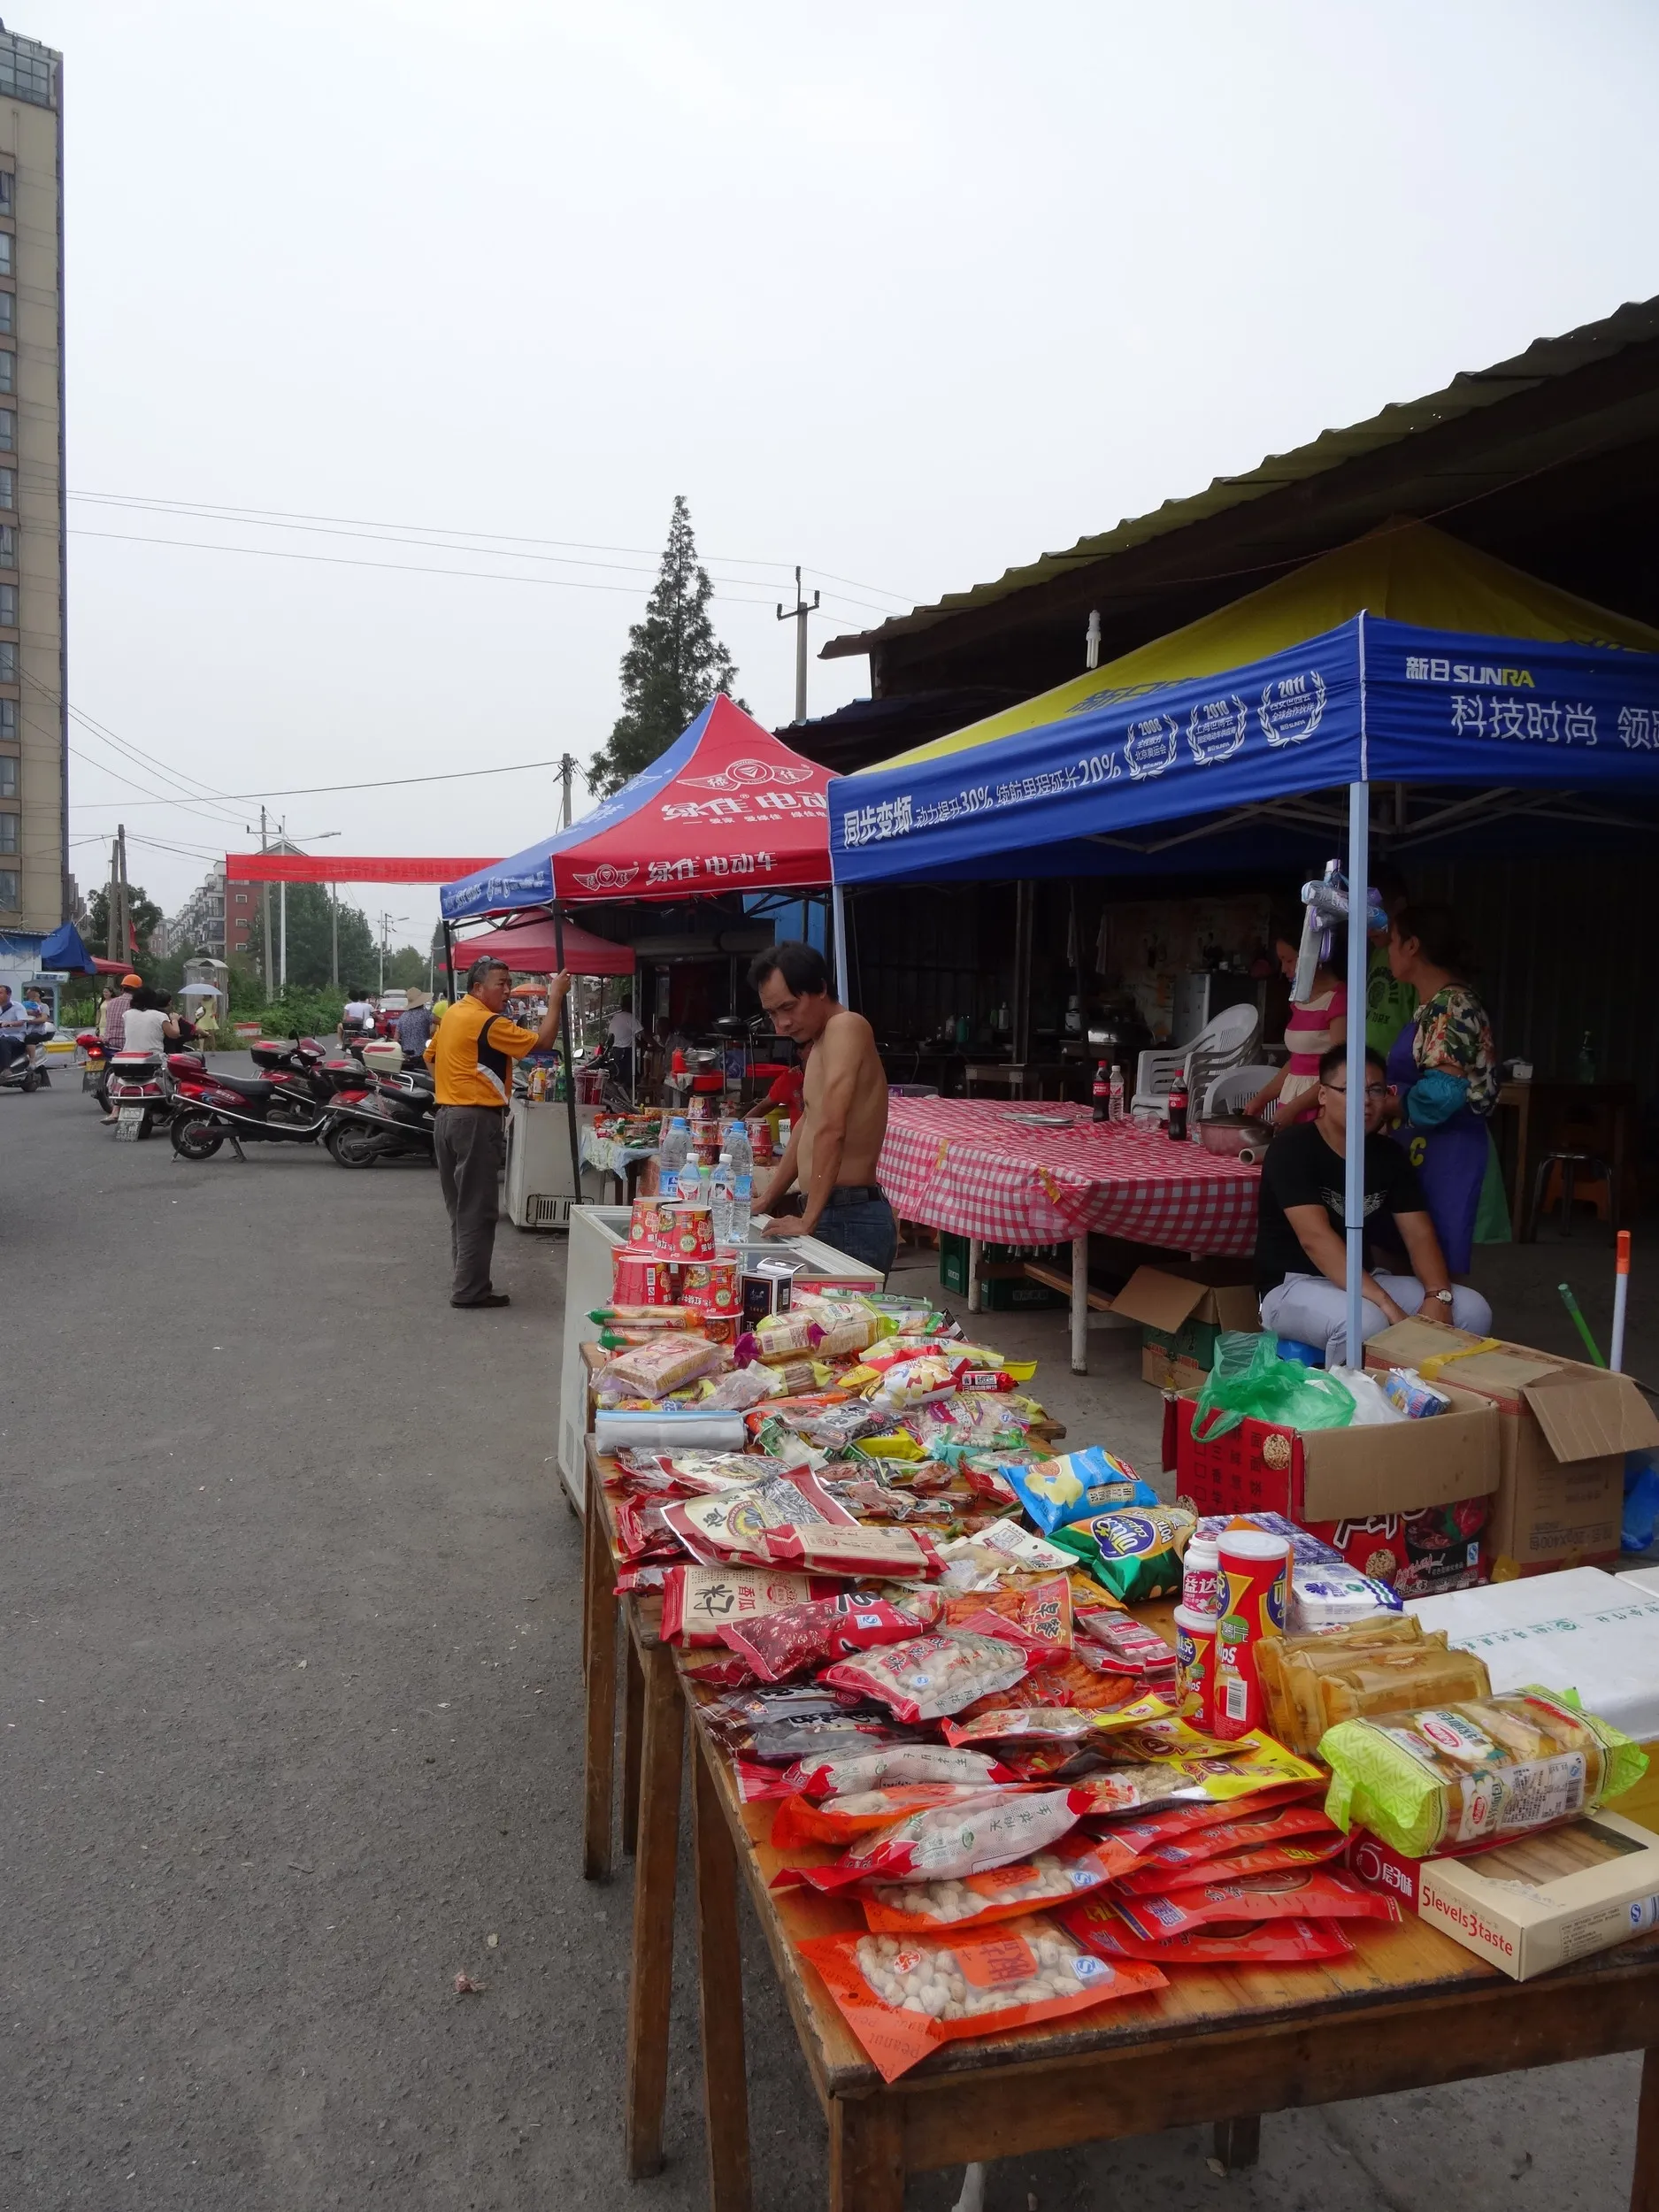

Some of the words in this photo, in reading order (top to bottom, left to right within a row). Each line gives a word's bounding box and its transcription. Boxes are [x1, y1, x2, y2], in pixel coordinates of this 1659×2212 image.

[1278, 675, 1306, 698] 2011
[1203, 700, 1230, 719] 2010
[1138, 718, 1163, 736] 2008
[1450, 694, 1598, 746] 科技时尚
[1617, 706, 1659, 750] 领
[843, 795, 912, 849] 同步变频
[704, 851, 779, 876] 电动车
[1184, 1576, 1217, 1594] 益达
[738, 1586, 756, 1611] 香瓜
